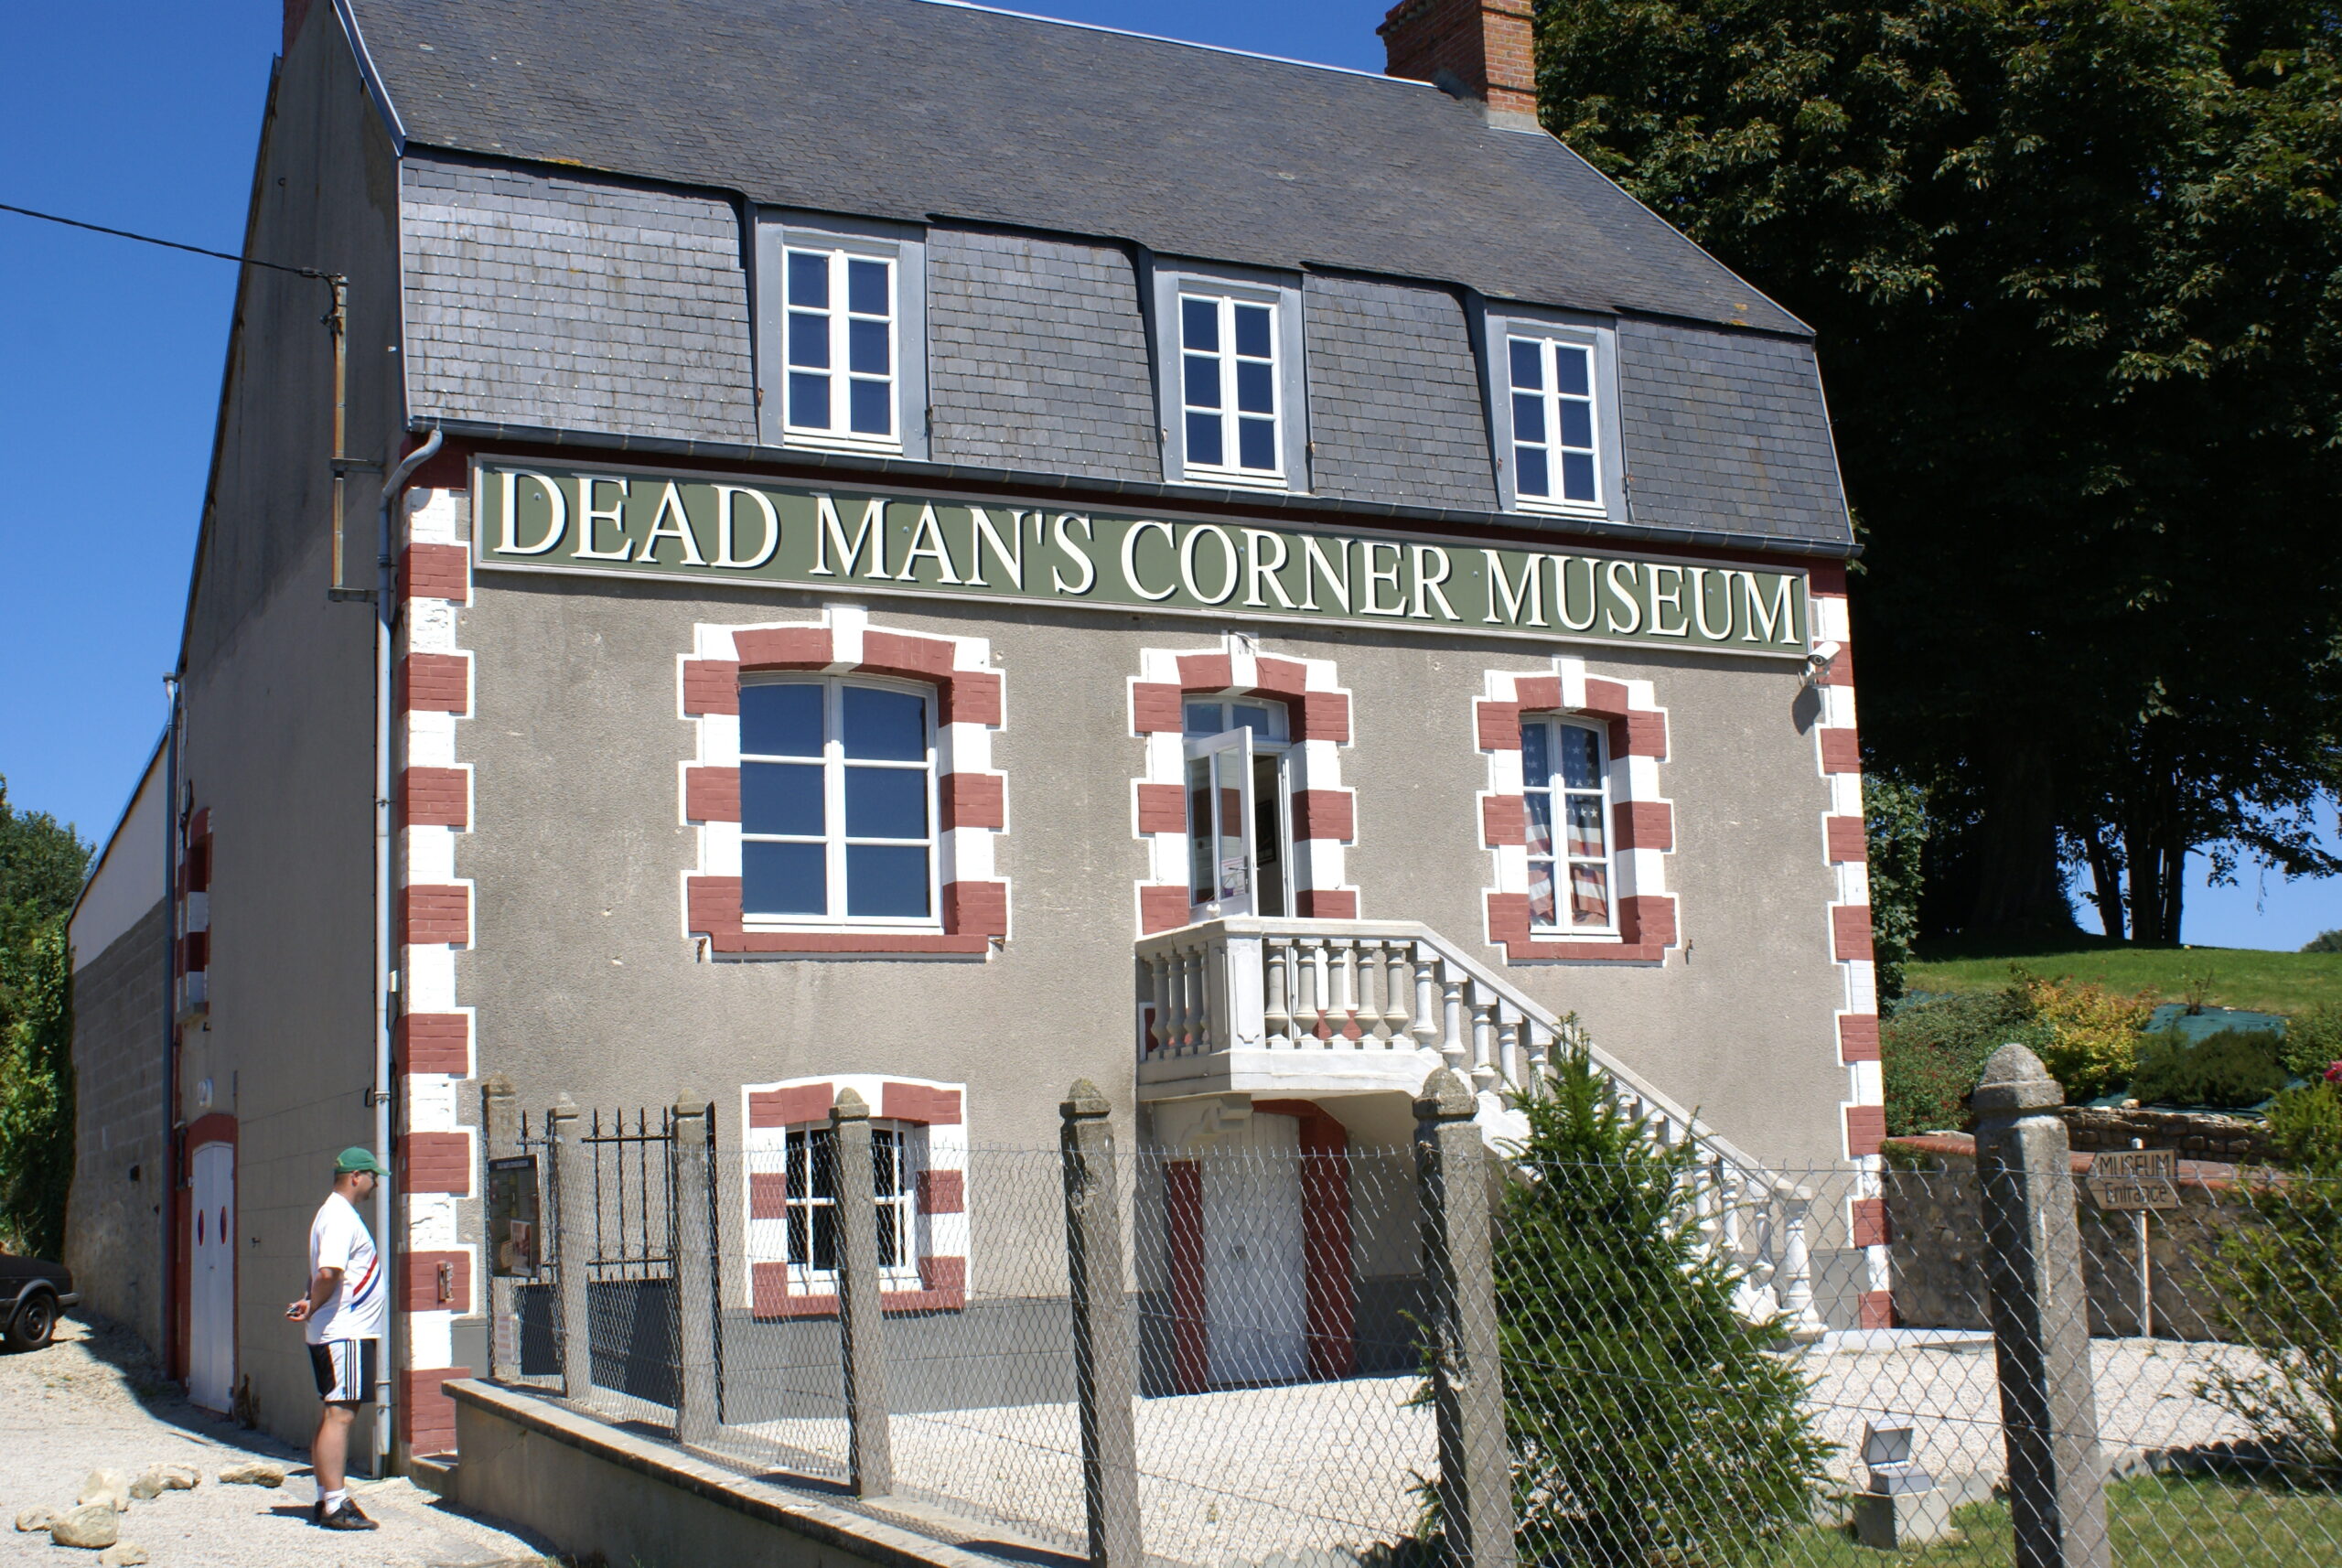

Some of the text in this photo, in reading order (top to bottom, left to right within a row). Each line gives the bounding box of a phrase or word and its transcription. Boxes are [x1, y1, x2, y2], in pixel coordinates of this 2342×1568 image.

[493, 467, 1802, 646] DEAD MAN'S CORNER MUSEUM
[2100, 1154, 2170, 1178] MUSEUM
[2105, 1182, 2167, 1203] Entrance
